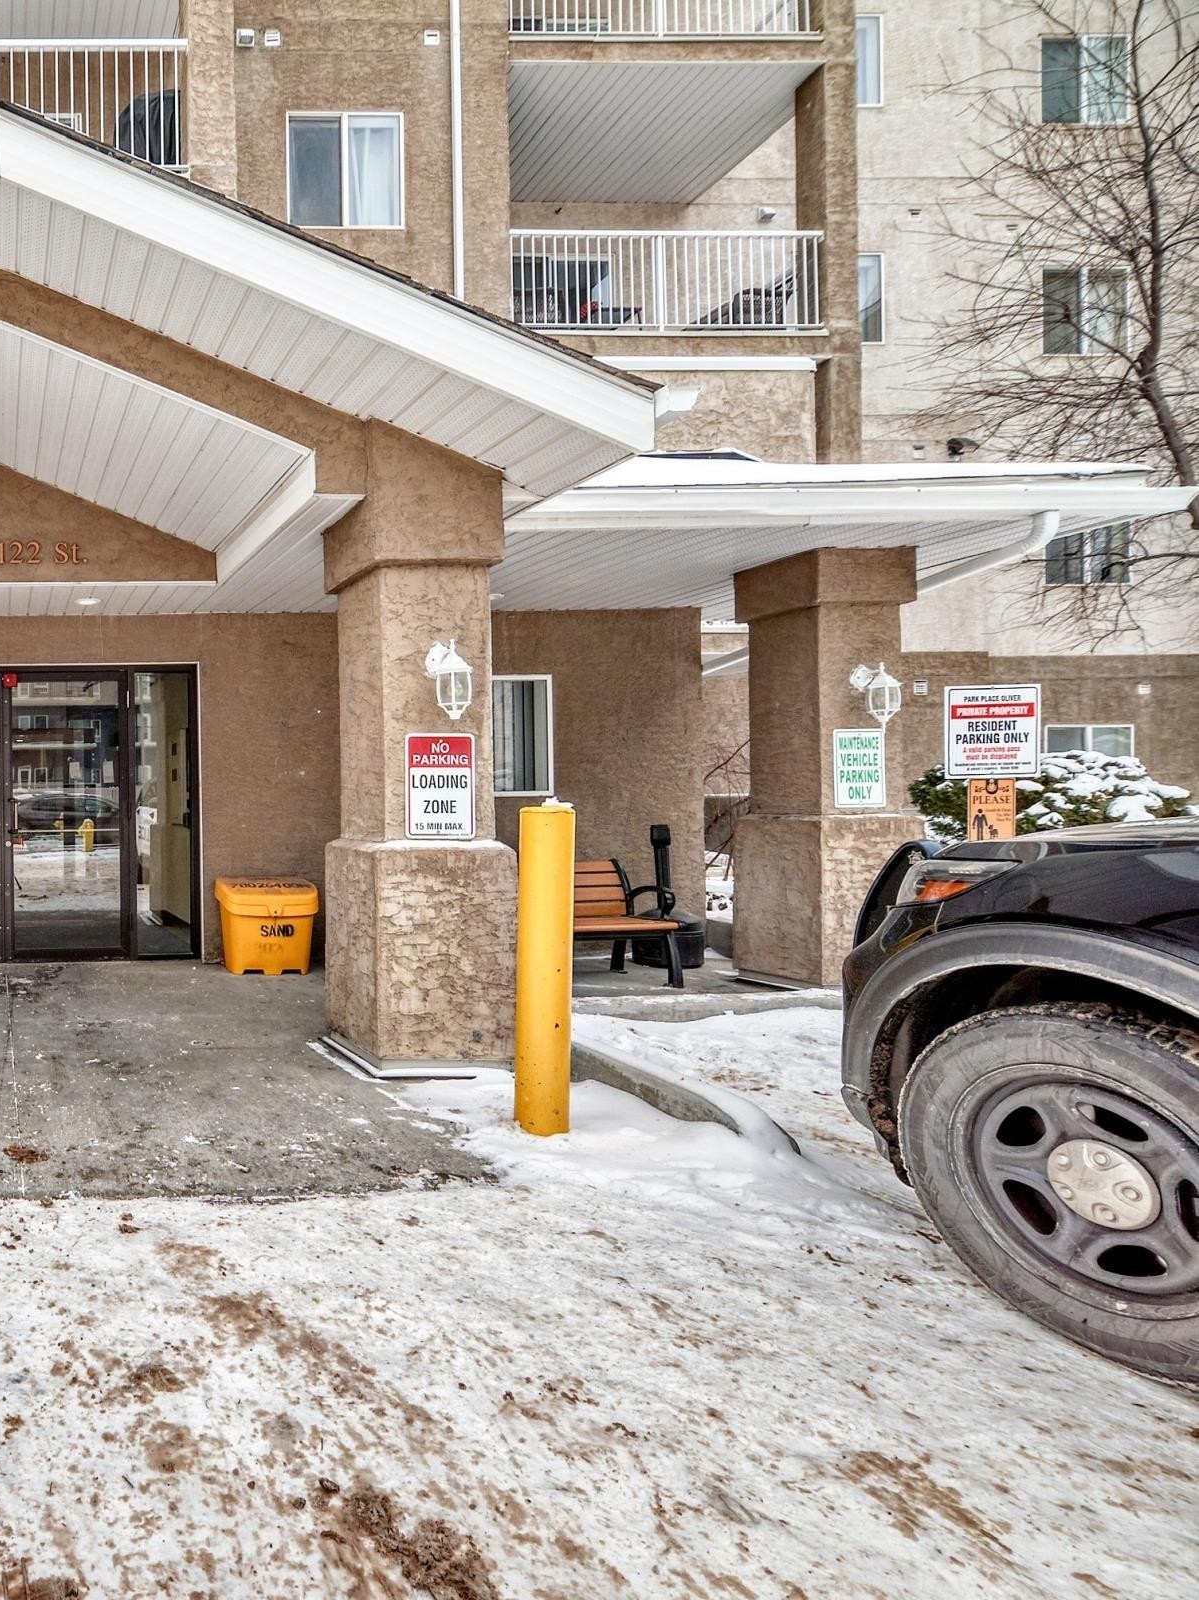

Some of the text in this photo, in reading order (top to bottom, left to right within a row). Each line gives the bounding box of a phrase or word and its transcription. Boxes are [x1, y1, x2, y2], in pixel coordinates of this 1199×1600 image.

[53, 541, 89, 564] St.
[963, 695, 980, 703] PARK
[956, 705, 1029, 717] PRIVATE PROPERTY
[967, 720, 1018, 732] RESIDENT
[838, 736, 880, 750] MAINTENANCE
[955, 732, 1030, 745] PARKING ONLY
[431, 742, 450, 753] NO
[983, 746, 1006, 754] parking
[412, 755, 469, 765] PARKING
[840, 753, 879, 767] VEHICLE
[412, 774, 468, 789] LOADING
[839, 769, 880, 783] PARKING
[848, 786, 872, 800] ONLY
[423, 799, 457, 814] ZONE
[972, 795, 1012, 805] PLEASE
[414, 822, 466, 831] 15 MIN MAX.
[260, 924, 295, 938] SAND
